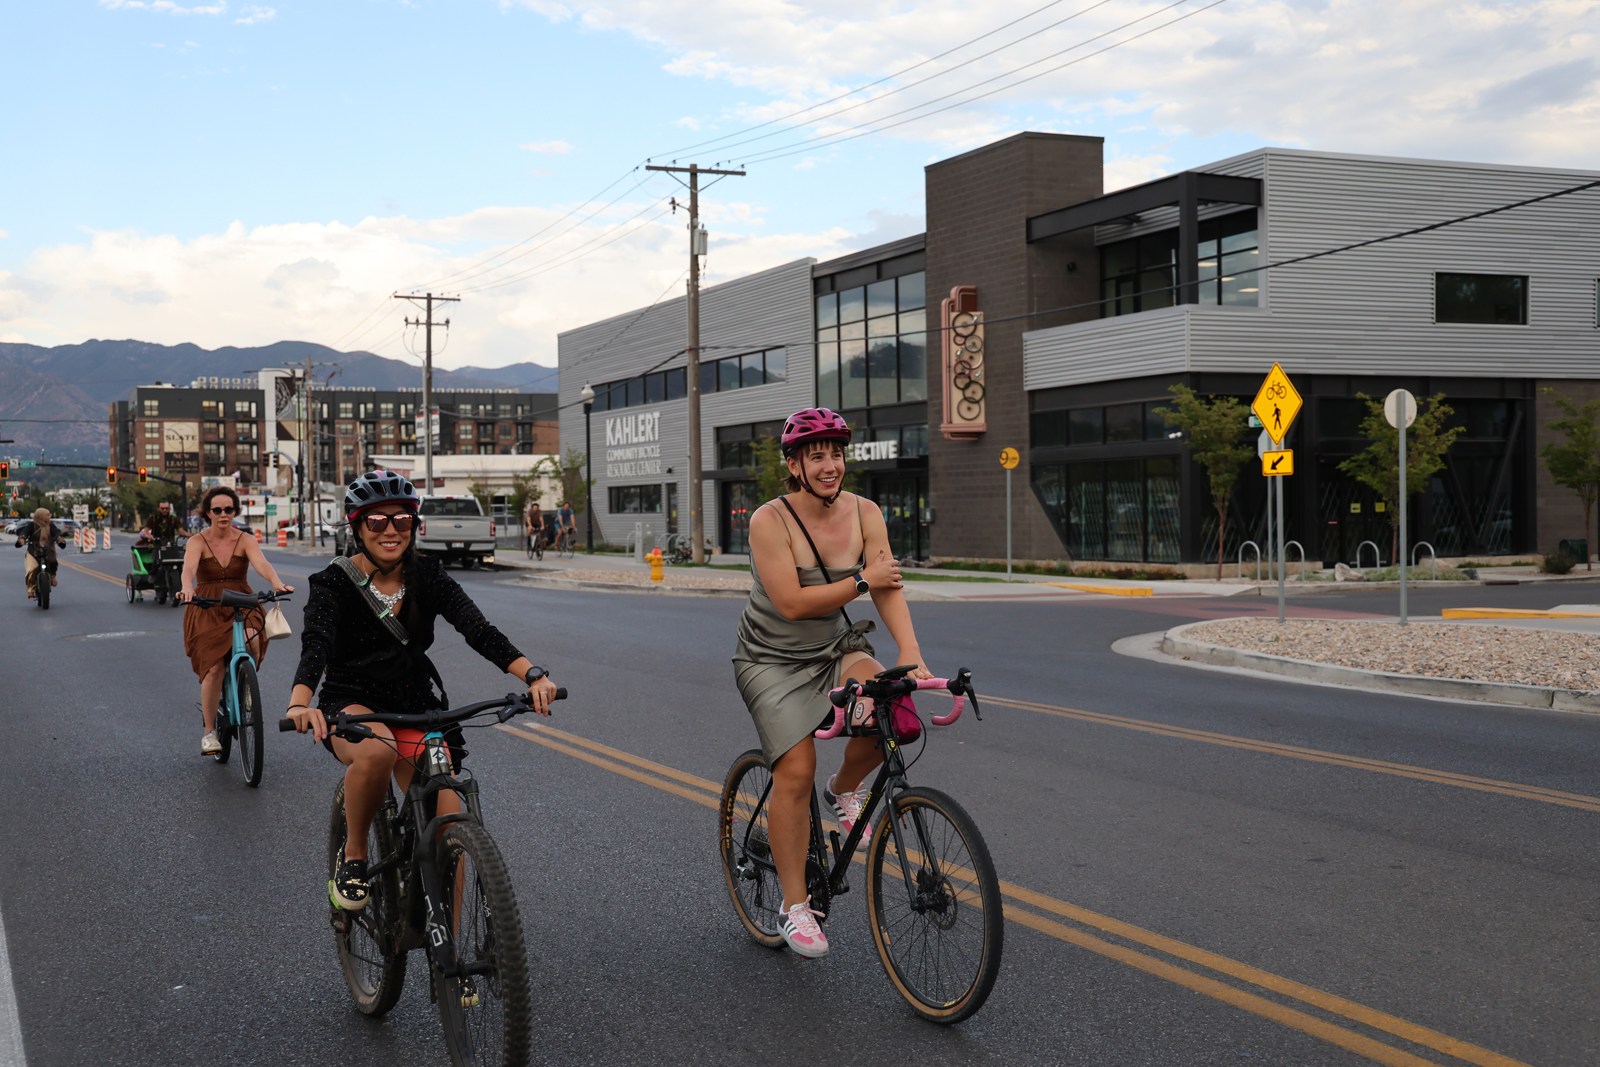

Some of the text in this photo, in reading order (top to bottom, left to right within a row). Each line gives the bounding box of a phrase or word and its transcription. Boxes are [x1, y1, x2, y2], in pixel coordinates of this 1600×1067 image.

[606, 411, 660, 446] KAHLERT
[607, 444, 661, 462] COMMUNITY BICYCLE
[1000, 450, 1009, 466] 9
[607, 459, 661, 477] RESOURCE CENTER
